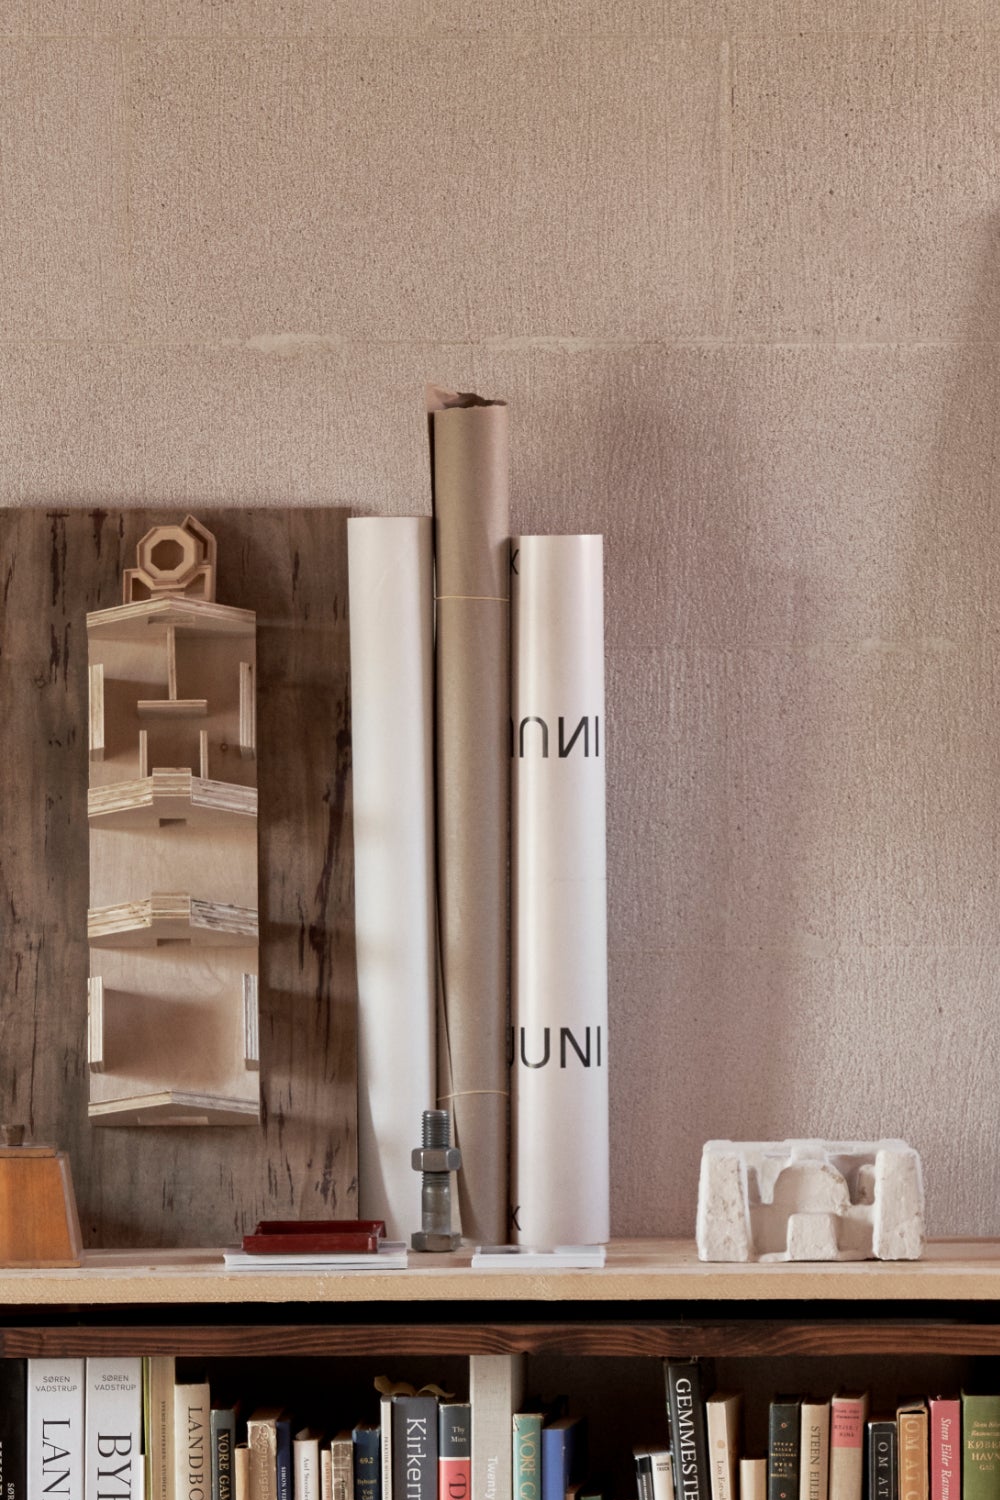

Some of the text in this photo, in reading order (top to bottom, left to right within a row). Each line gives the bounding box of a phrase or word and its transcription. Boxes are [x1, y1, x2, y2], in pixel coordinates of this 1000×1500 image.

[35, 1384, 78, 1393] VADSTRUP
[43, 1375, 71, 1384] SØREN
[94, 1383, 137, 1391] VADSTRUP
[101, 1374, 129, 1382] SØREN
[905, 1420, 920, 1450] OM
[940, 1418, 952, 1440] Steen
[218, 1432, 230, 1471] VORE
[519, 1432, 535, 1476] VORE
[809, 1425, 821, 1465] STEEN
[878, 1441, 888, 1468] OM
[940, 1443, 952, 1466] Eiler
[486, 1456, 499, 1500] Twenty
[905, 1462, 920, 1484] AT
[878, 1477, 888, 1498] AT
